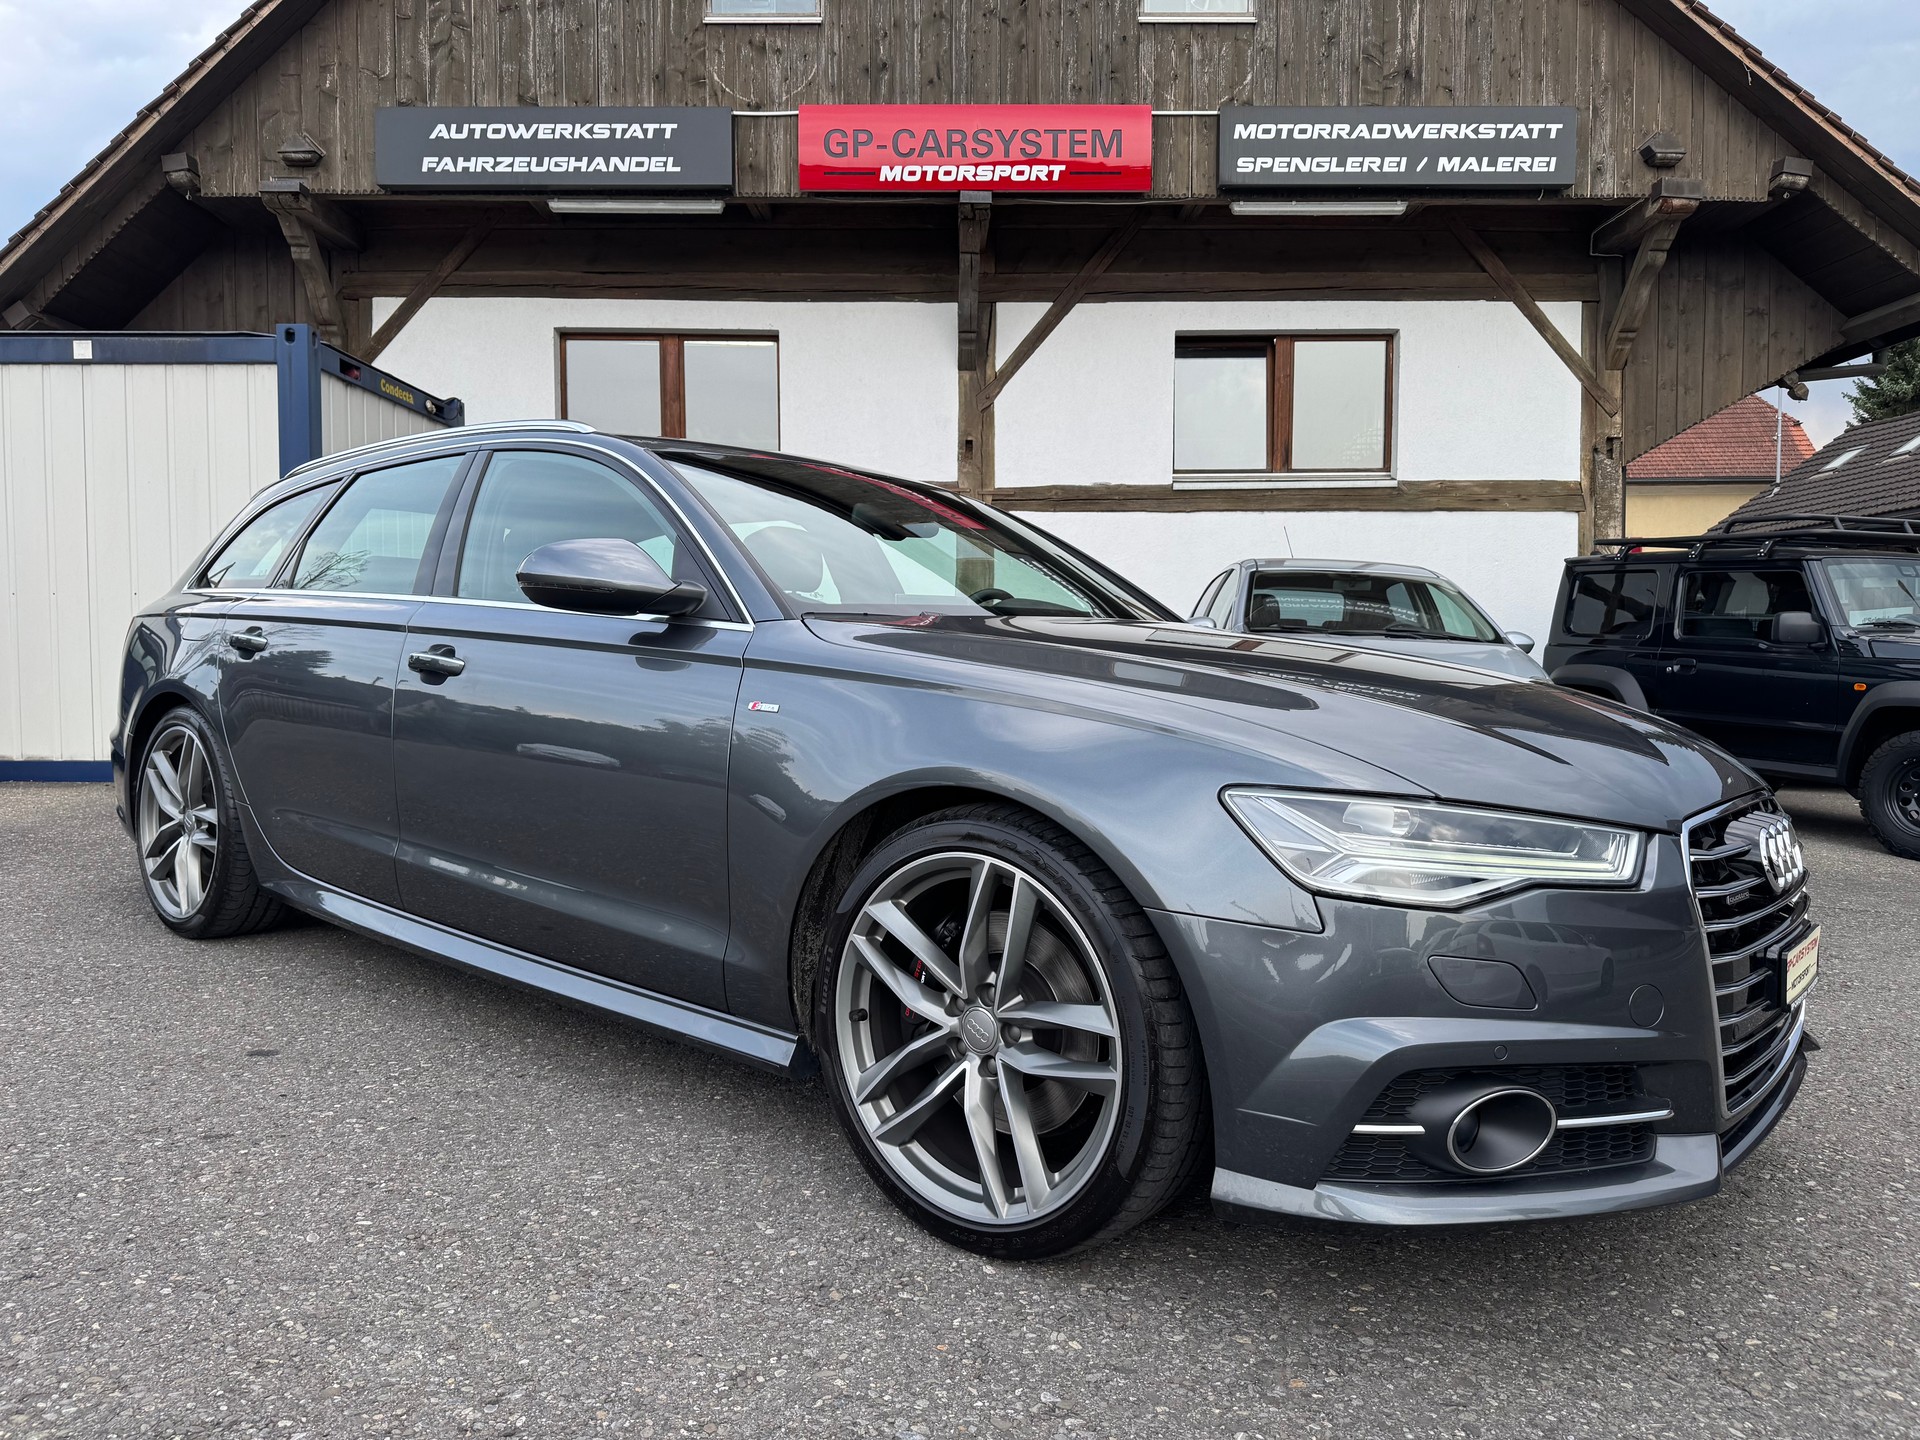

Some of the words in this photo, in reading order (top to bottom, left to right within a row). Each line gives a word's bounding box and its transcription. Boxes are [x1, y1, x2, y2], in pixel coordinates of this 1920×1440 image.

[429, 123, 678, 139] AUTOWERKSTATT
[1233, 123, 1564, 139] MOTORRADWERKSTATT
[823, 129, 1123, 158] GP-CARSYSTEM
[421, 156, 681, 172] FAHRZEUGHANDEL
[1236, 156, 1407, 173] SPENGLEREI
[1416, 157, 1429, 172] /
[1437, 156, 1557, 173] MALEREI
[879, 164, 1067, 182] MOTORSPORT
[381, 378, 414, 404] Condecta
